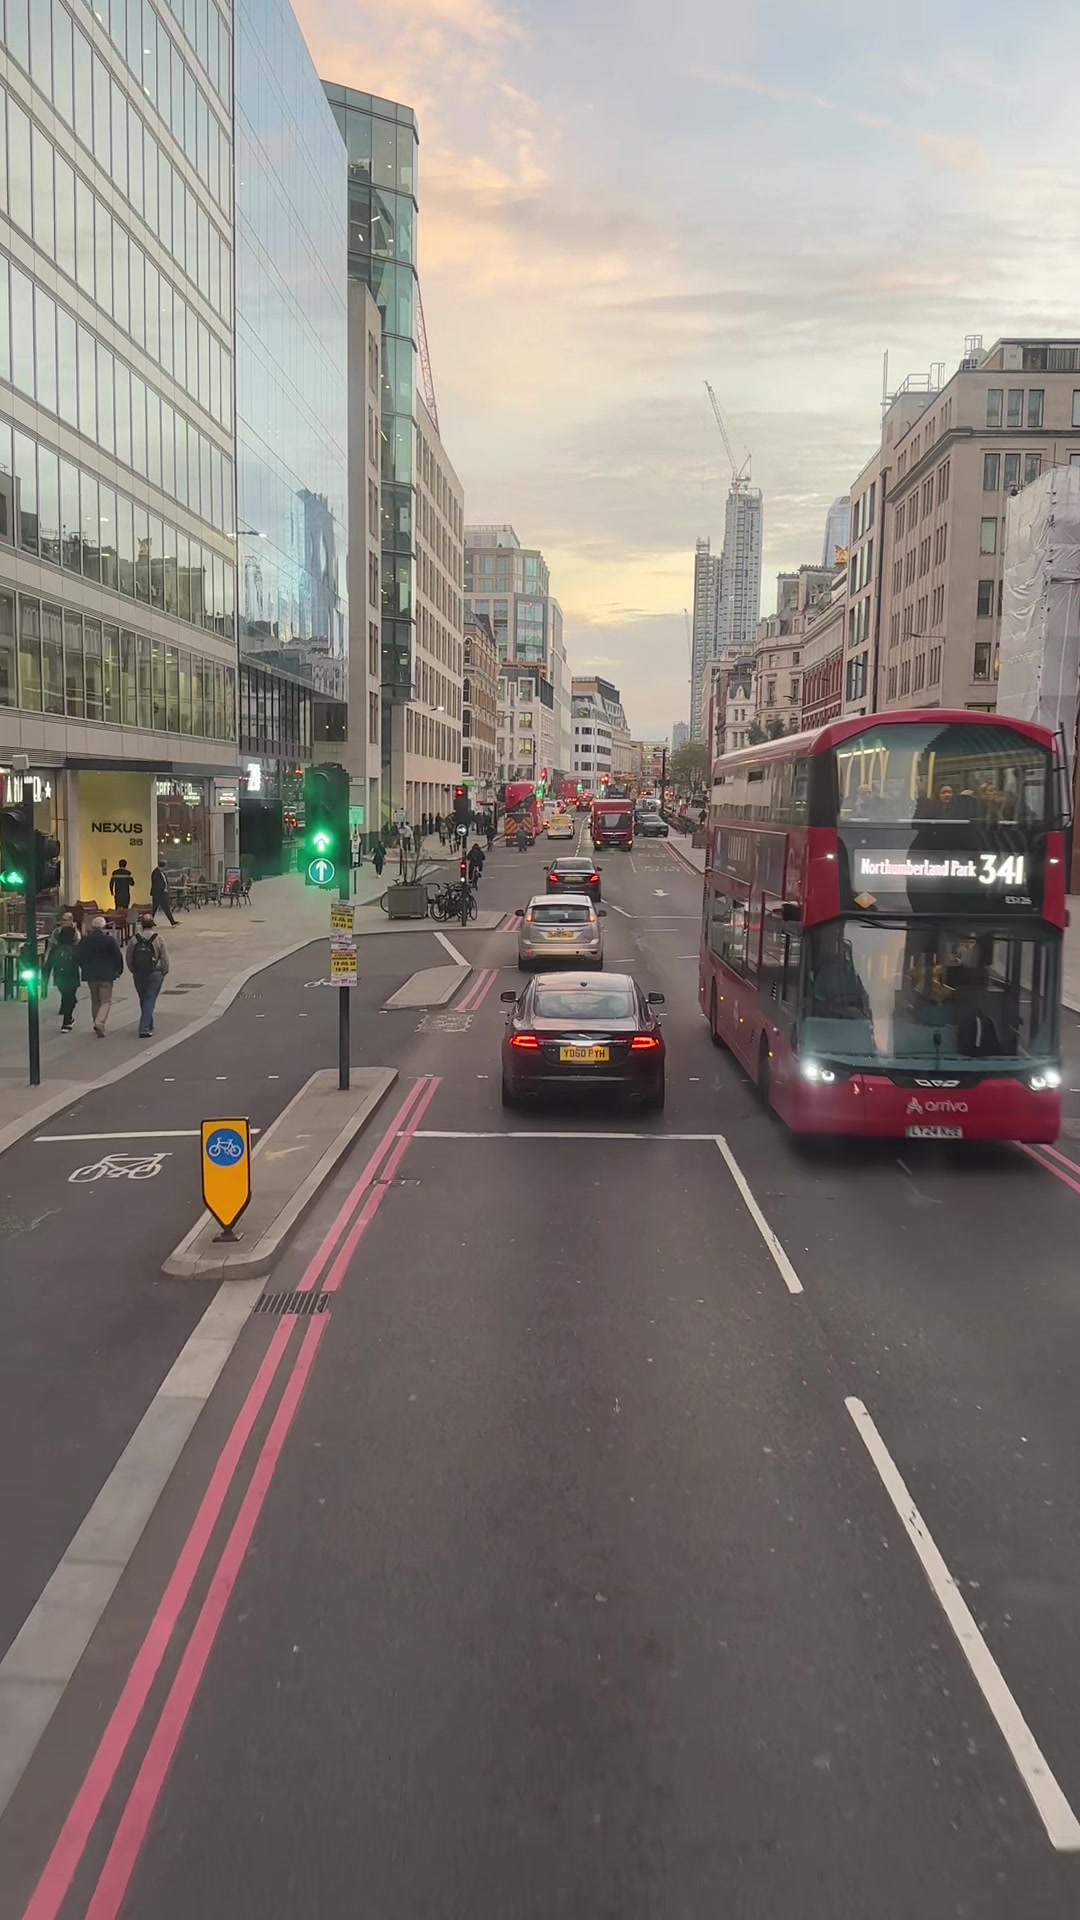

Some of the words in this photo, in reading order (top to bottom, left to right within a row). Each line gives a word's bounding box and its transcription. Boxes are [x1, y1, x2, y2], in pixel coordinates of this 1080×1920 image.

[91, 822, 143, 834] NEXUS
[861, 858, 949, 876] Northumberland
[951, 860, 977, 877] Park
[979, 854, 1024, 885] 341
[588, 1048, 605, 1058] PYH
[924, 1100, 969, 1113] arriva
